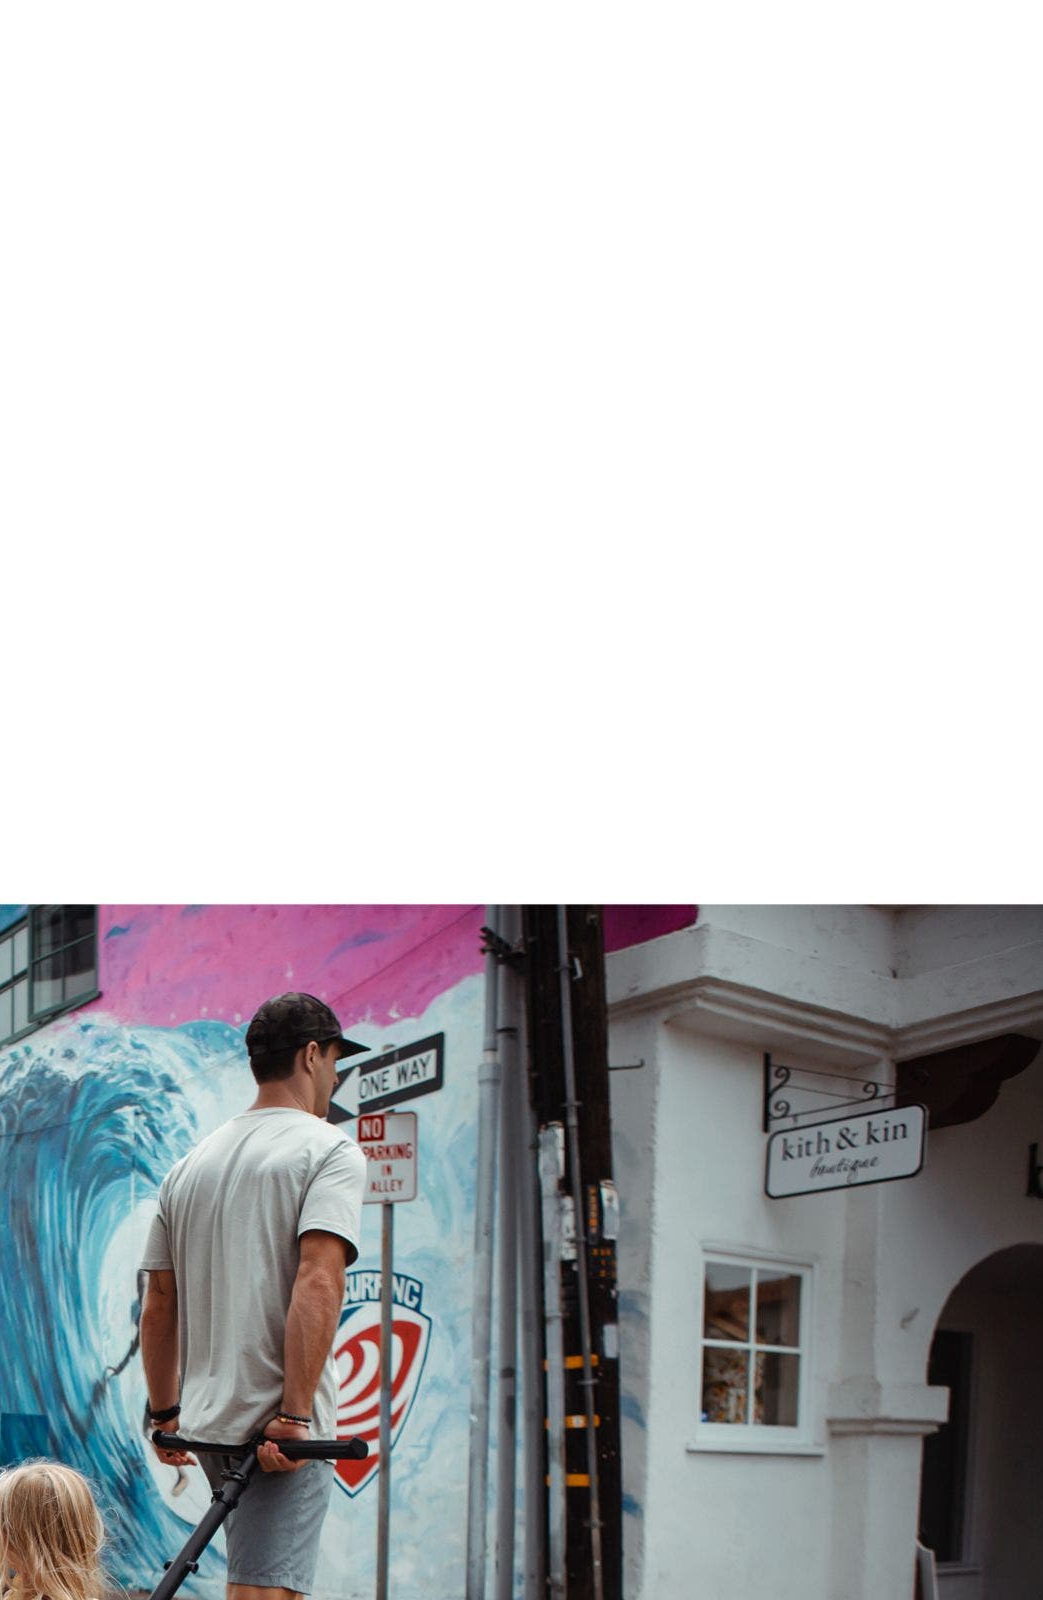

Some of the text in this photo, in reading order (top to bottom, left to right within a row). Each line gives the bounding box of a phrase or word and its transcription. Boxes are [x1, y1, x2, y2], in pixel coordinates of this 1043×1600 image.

[359, 1055, 431, 1099] ONE WAY
[361, 1119, 383, 1139] NO
[781, 1120, 907, 1161] kith & kin
[363, 1143, 412, 1161] PARKING
[382, 1164, 392, 1176] IN
[809, 1156, 879, 1184] boutique
[371, 1179, 404, 1193] ALLEY
[343, 1272, 420, 1309] URFNG
